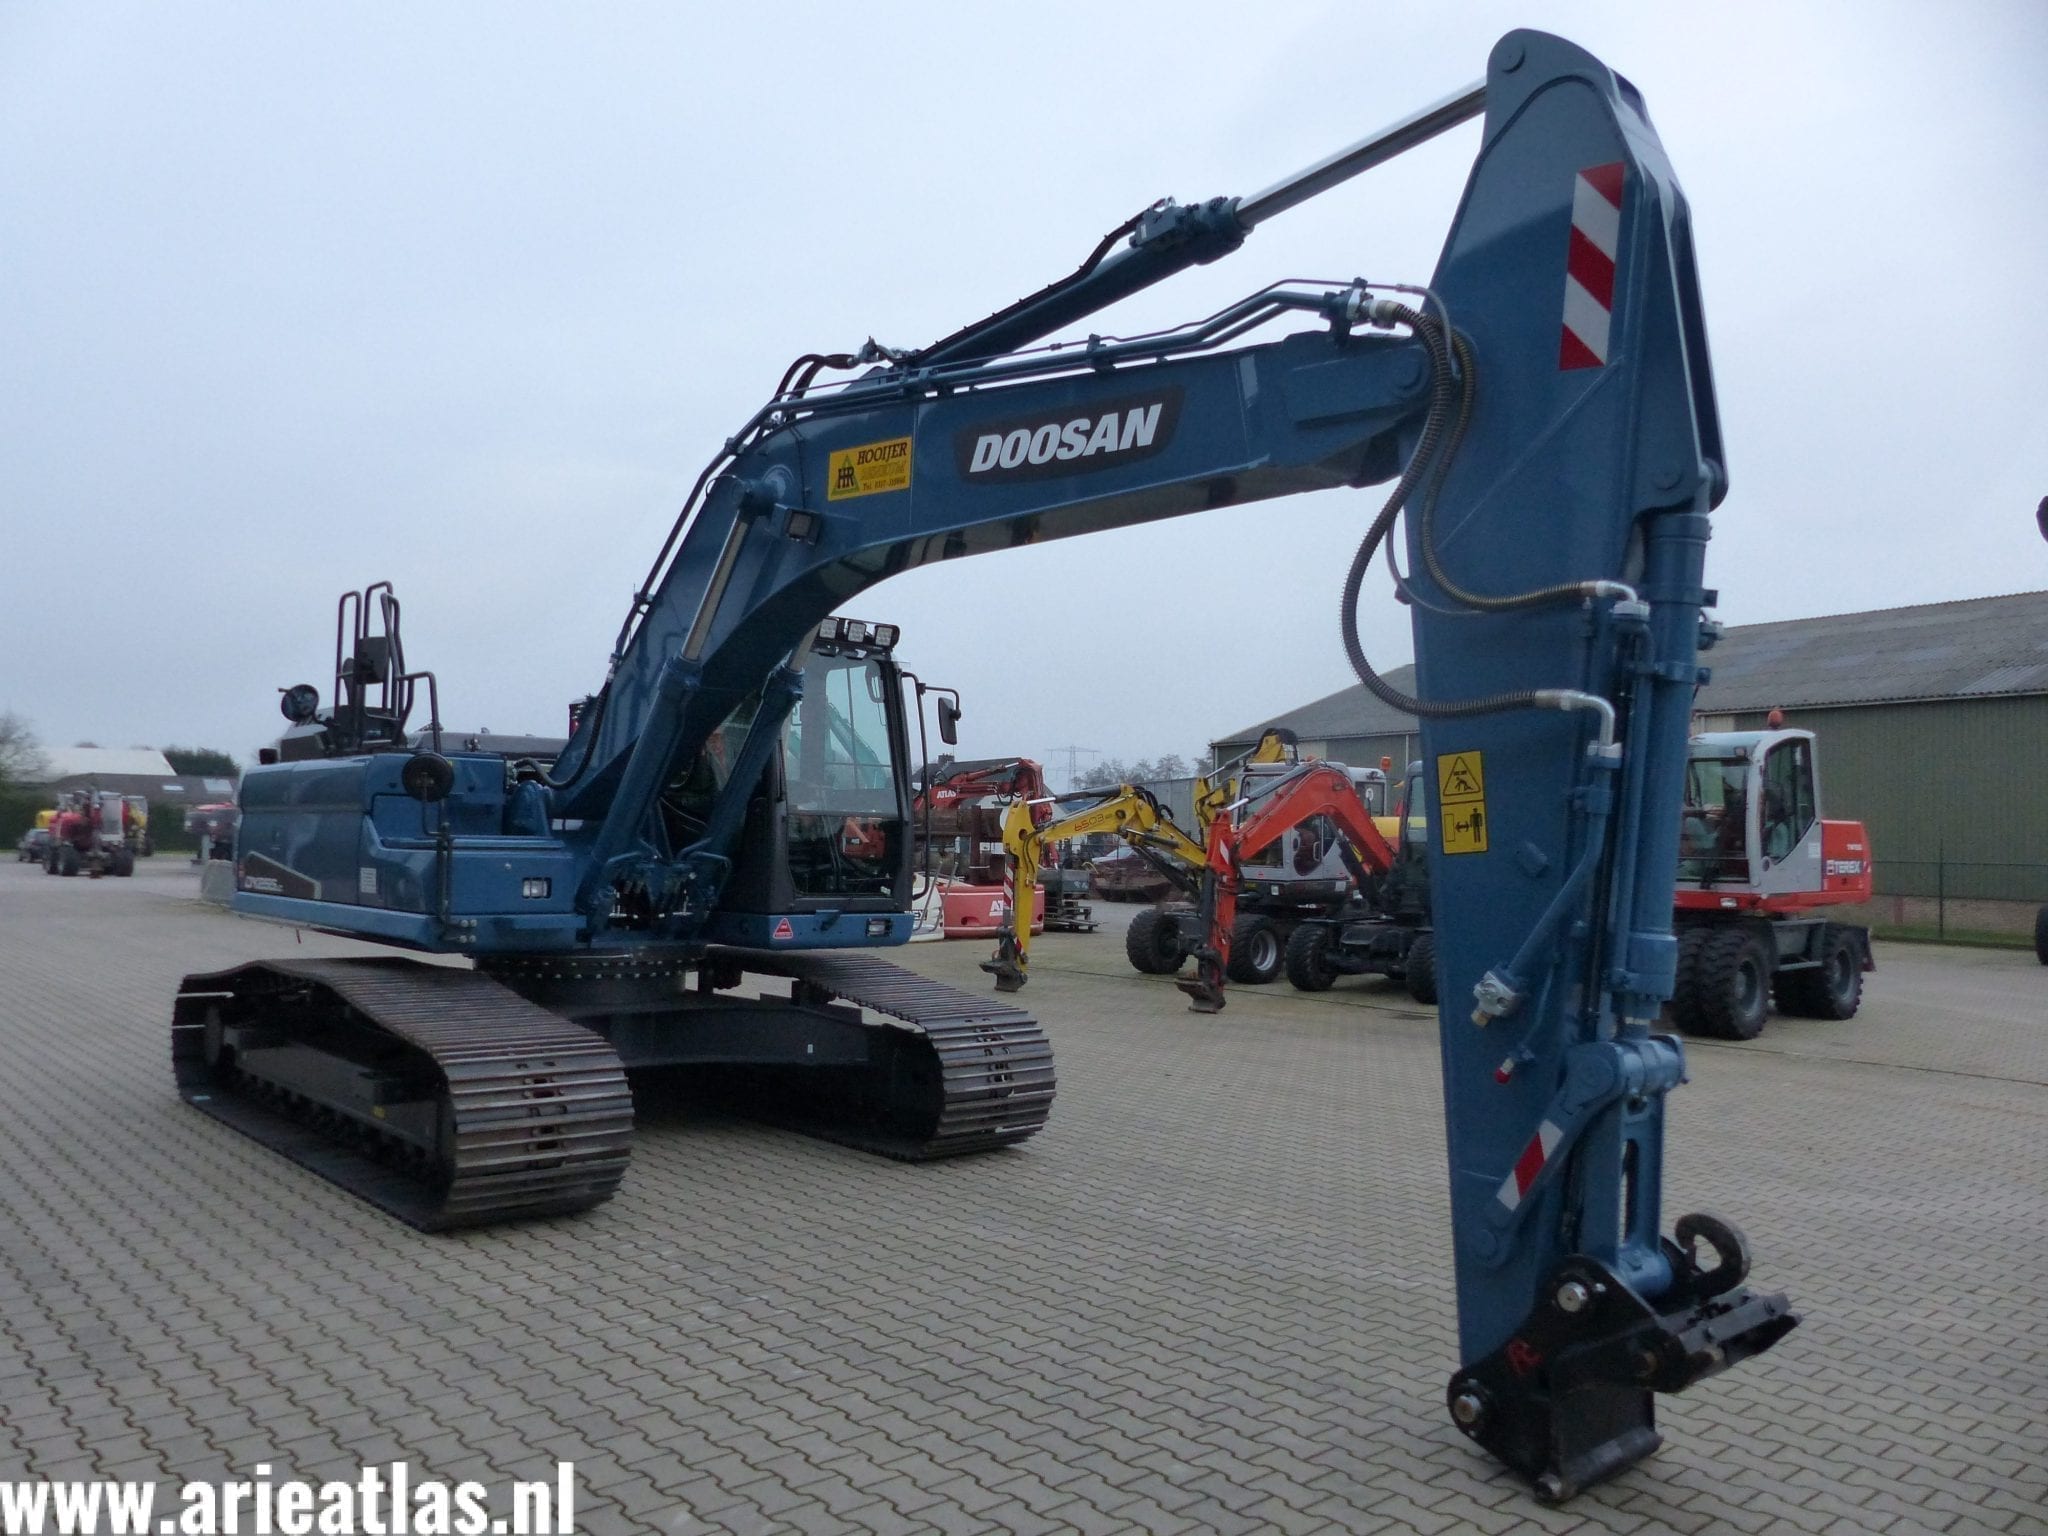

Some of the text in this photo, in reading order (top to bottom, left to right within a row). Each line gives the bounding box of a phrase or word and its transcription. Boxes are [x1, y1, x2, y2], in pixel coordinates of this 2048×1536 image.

[969, 403, 1163, 473] DOOSAN
[857, 442, 908, 466] HOOIJER
[936, 789, 957, 799] ATLAS
